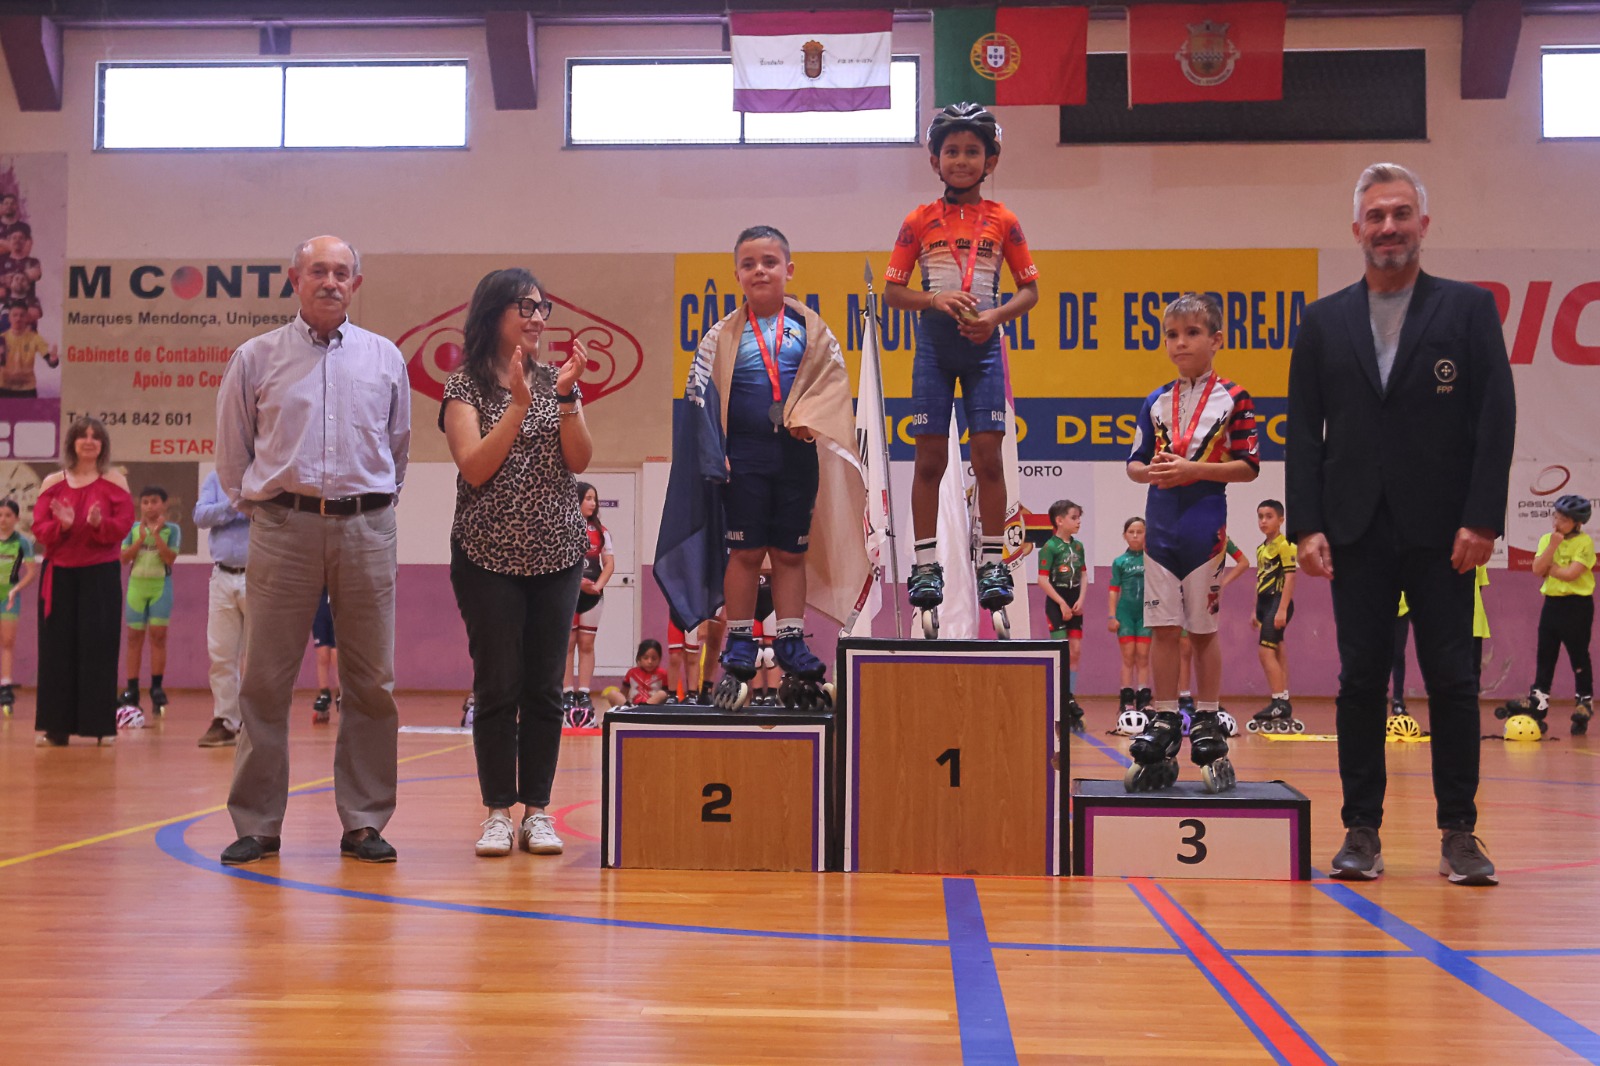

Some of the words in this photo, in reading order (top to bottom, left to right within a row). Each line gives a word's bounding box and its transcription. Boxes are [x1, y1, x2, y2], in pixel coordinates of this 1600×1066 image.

[68, 266, 111, 299] M
[67, 311, 133, 327] Marques
[1059, 292, 1098, 350] DE
[67, 345, 130, 363] Gabinete
[134, 346, 151, 363] de
[132, 370, 172, 391] Apoio
[176, 374, 194, 388] ao
[100, 412, 127, 425] 234
[132, 412, 160, 425] 842
[165, 412, 192, 425] 601
[935, 748, 961, 788] 1
[701, 782, 732, 822] 2
[1176, 818, 1208, 865] 3
